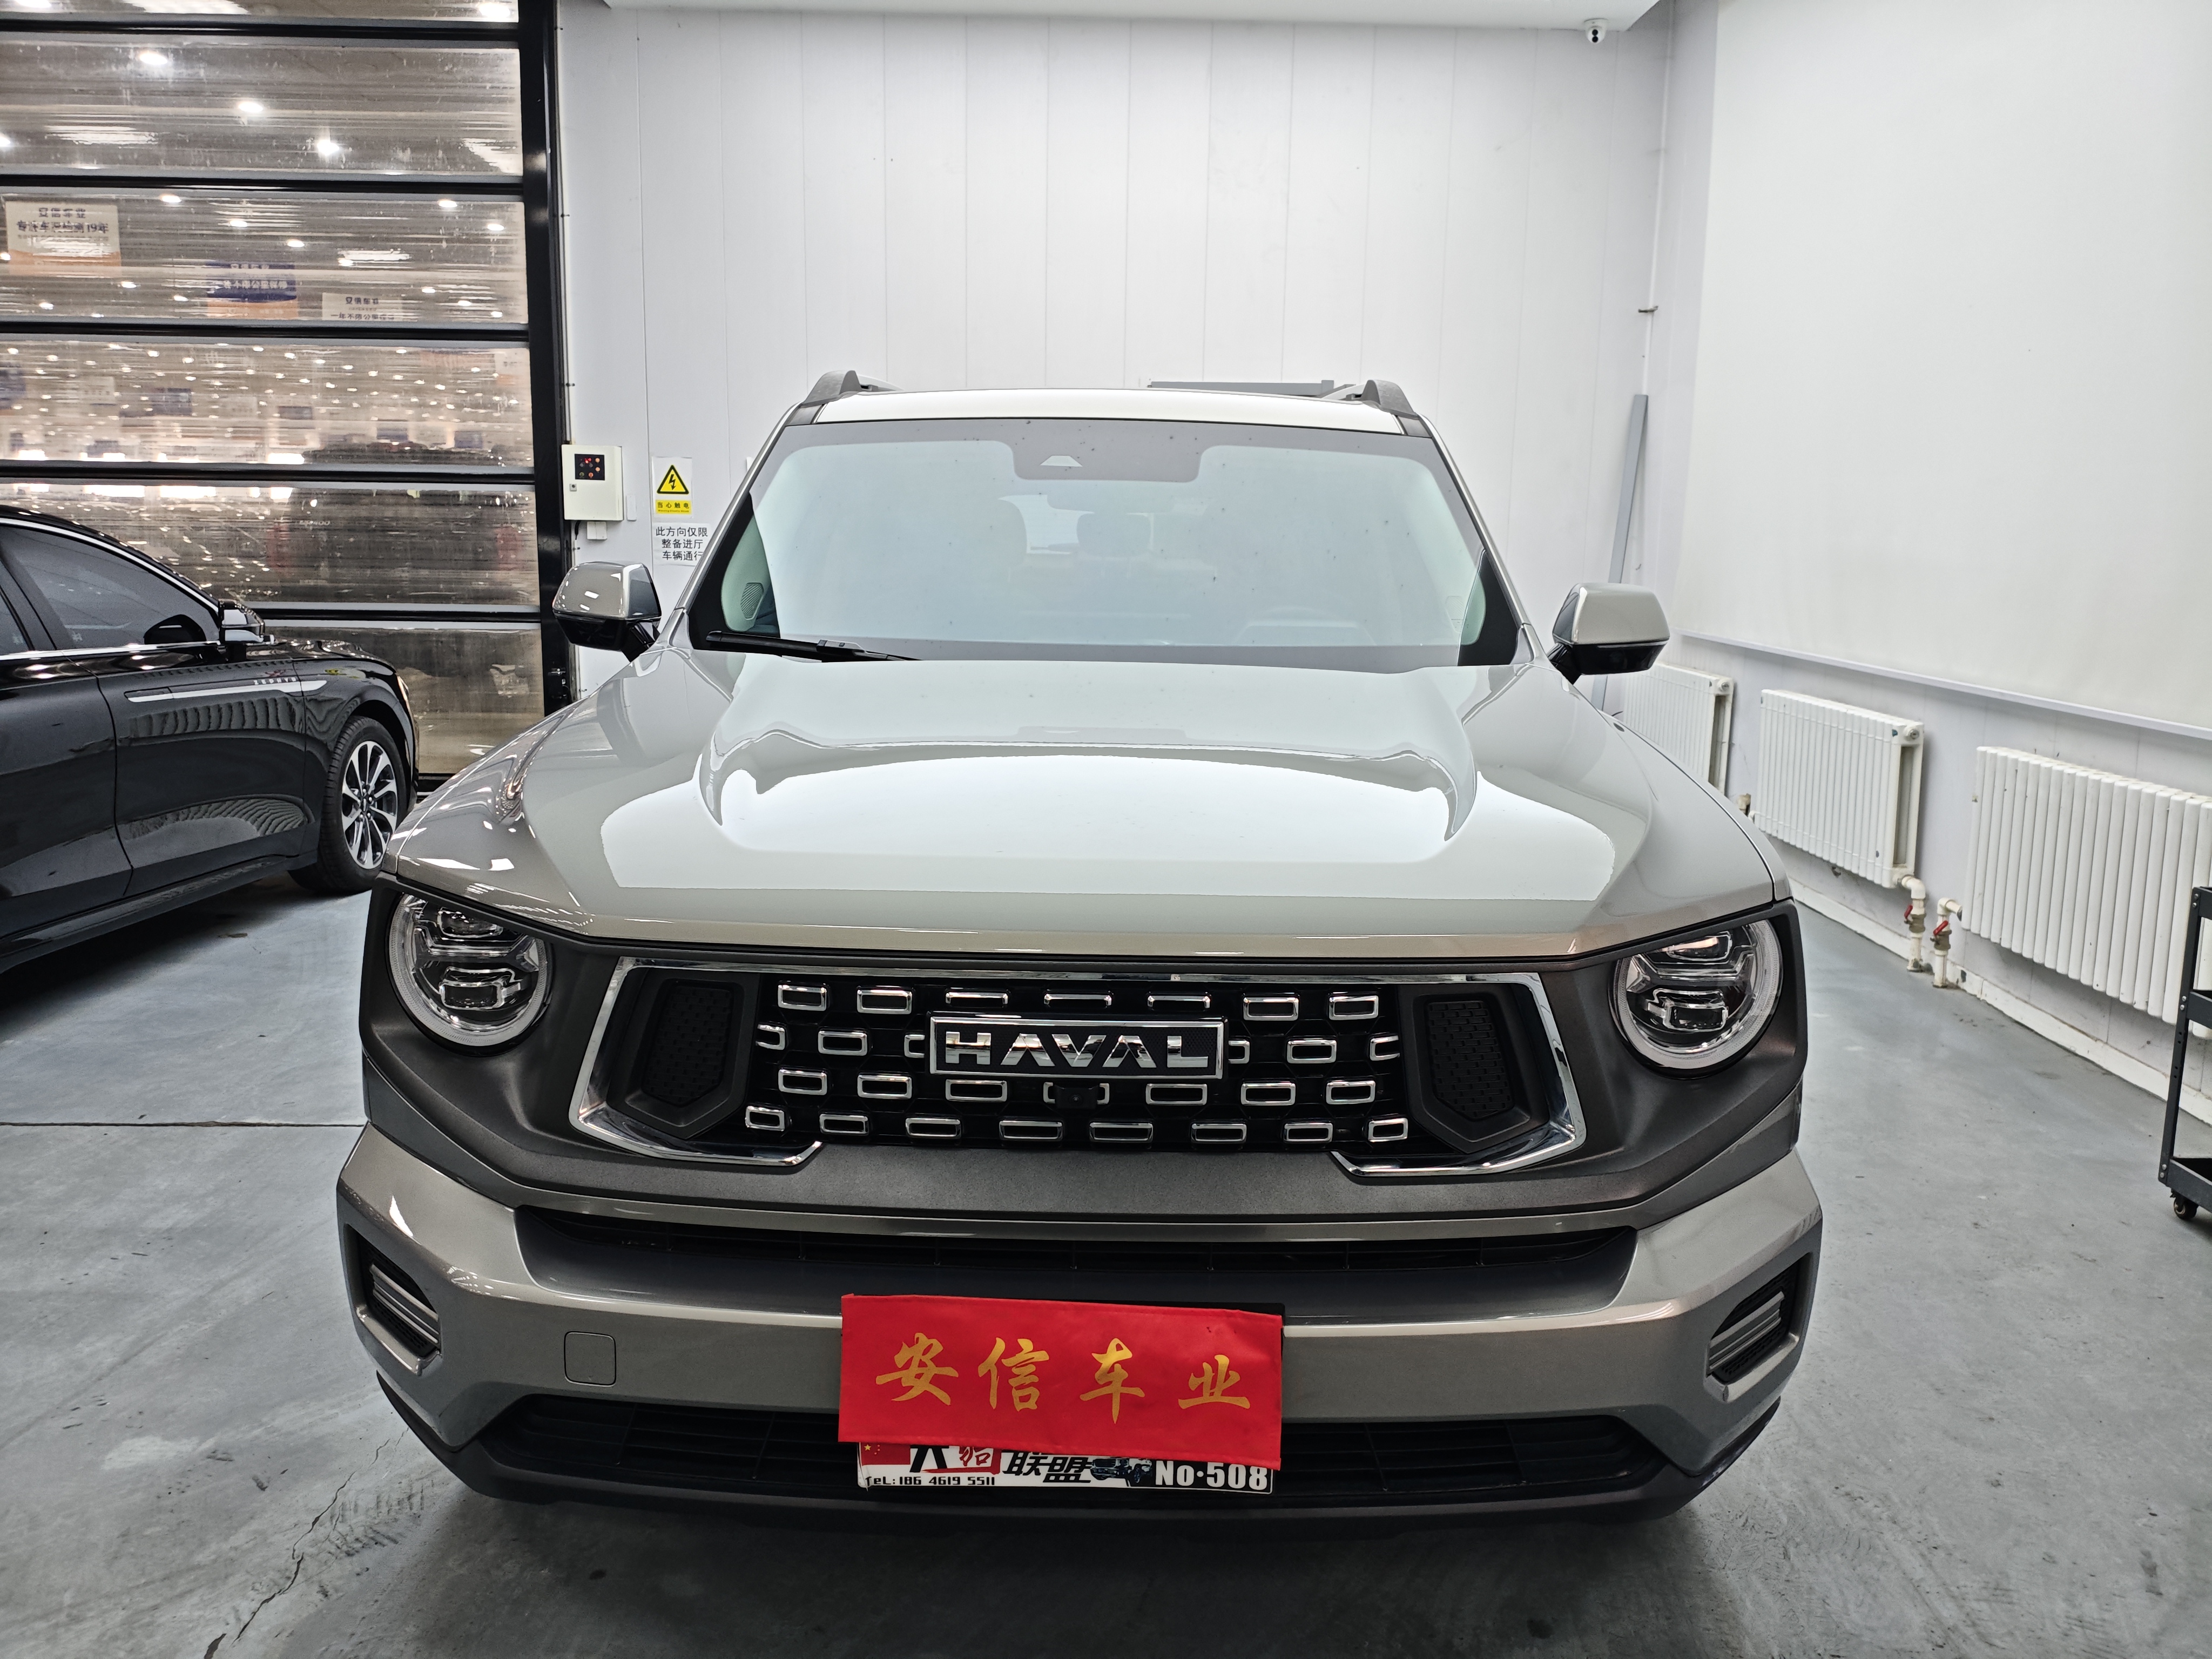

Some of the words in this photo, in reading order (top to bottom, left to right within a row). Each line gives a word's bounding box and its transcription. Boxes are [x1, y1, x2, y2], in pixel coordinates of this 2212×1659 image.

[656, 526, 708, 537] 此方向仅限
[662, 538, 704, 549] 整备进厅
[662, 550, 703, 561] 车辆通行
[946, 1031, 1208, 1068] HAVAL
[875, 1332, 1251, 1425] 安信车业
[928, 1476, 961, 1486] 4619
[967, 1476, 995, 1486] 5511
